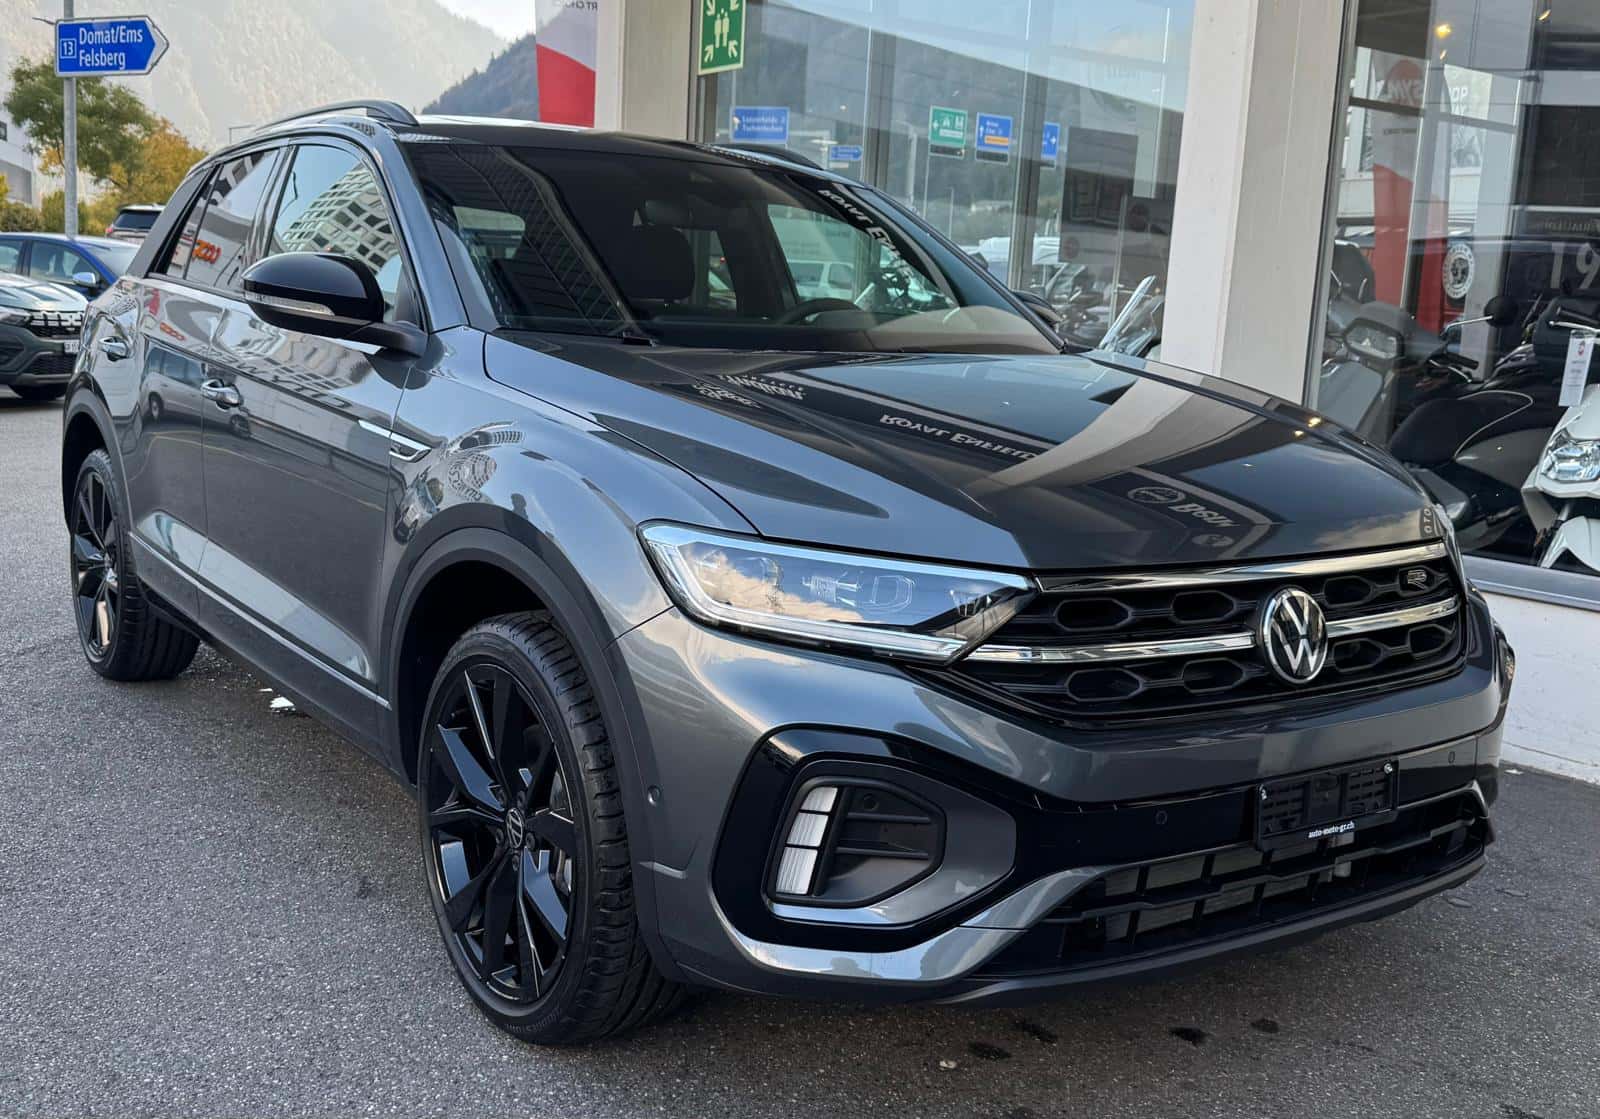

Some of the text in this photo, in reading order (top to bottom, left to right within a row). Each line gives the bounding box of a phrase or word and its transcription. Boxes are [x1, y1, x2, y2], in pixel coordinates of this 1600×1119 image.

[79, 25, 143, 45] Domat/Ems
[63, 41, 74, 56] 13
[79, 47, 126, 70] Felsberg
